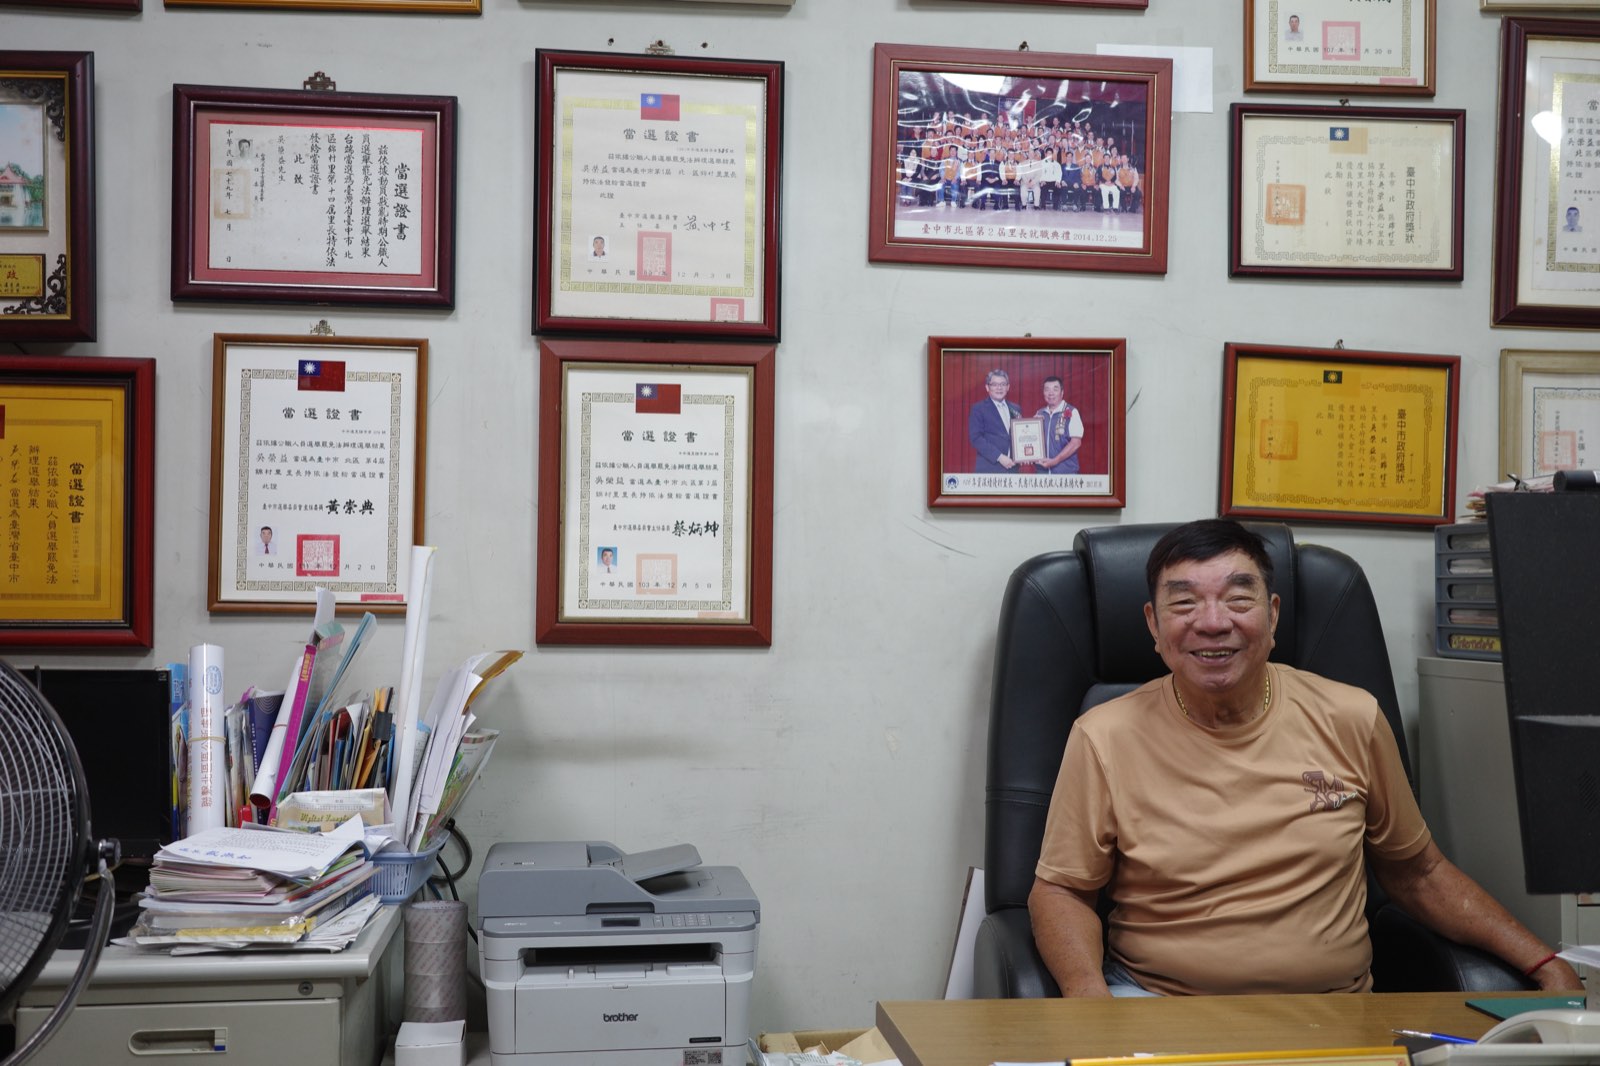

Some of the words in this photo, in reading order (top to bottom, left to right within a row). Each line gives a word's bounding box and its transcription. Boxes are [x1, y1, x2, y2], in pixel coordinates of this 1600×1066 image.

[623, 128, 700, 143] 當選證書
[293, 153, 305, 185] 此致
[393, 162, 411, 241] 當選證書
[1405, 166, 1416, 244] 臺中市政府獎狀
[921, 223, 1071, 241] 臺中市北區第2屆里長就職典禮
[282, 407, 363, 421] 當選證書
[621, 430, 698, 443] 當選證書
[1395, 408, 1407, 484] 臺中市政府獎狀
[68, 462, 85, 524] 當選證書
[672, 520, 719, 538] 蔡炳坤
[603, 1013, 638, 1022] brother
